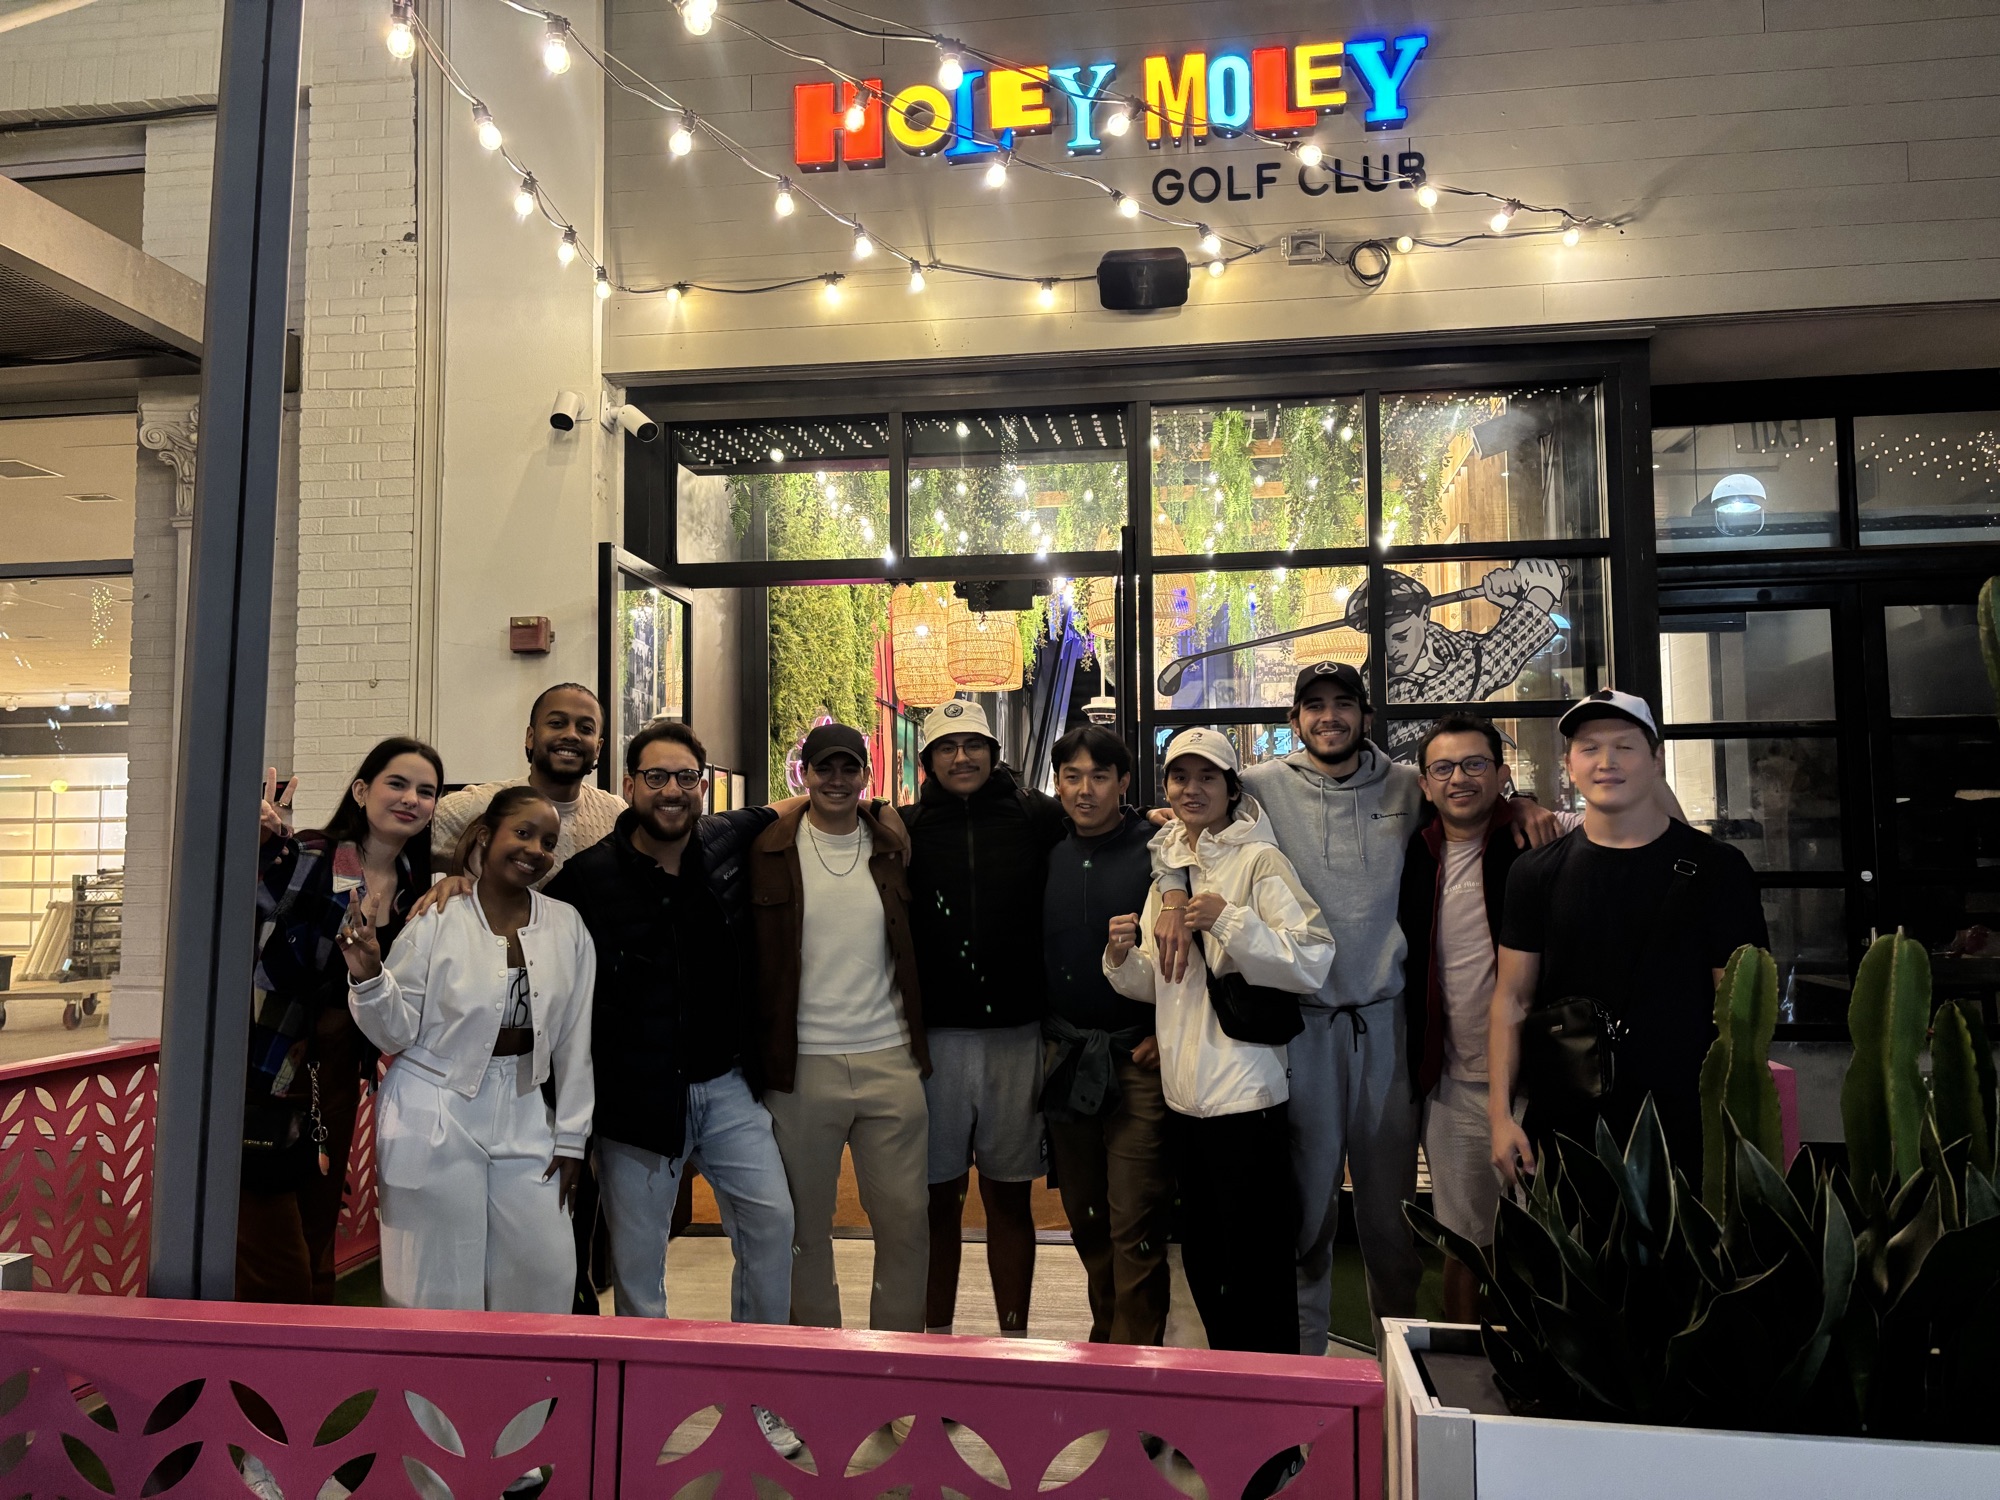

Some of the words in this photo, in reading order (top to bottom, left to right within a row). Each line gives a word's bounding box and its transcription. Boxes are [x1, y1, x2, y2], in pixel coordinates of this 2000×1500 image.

[794, 64, 1116, 167] HOLEY
[1143, 34, 1429, 143] MOLEY
[1151, 162, 1282, 206] GOLF
[1297, 151, 1427, 196] CLUB
